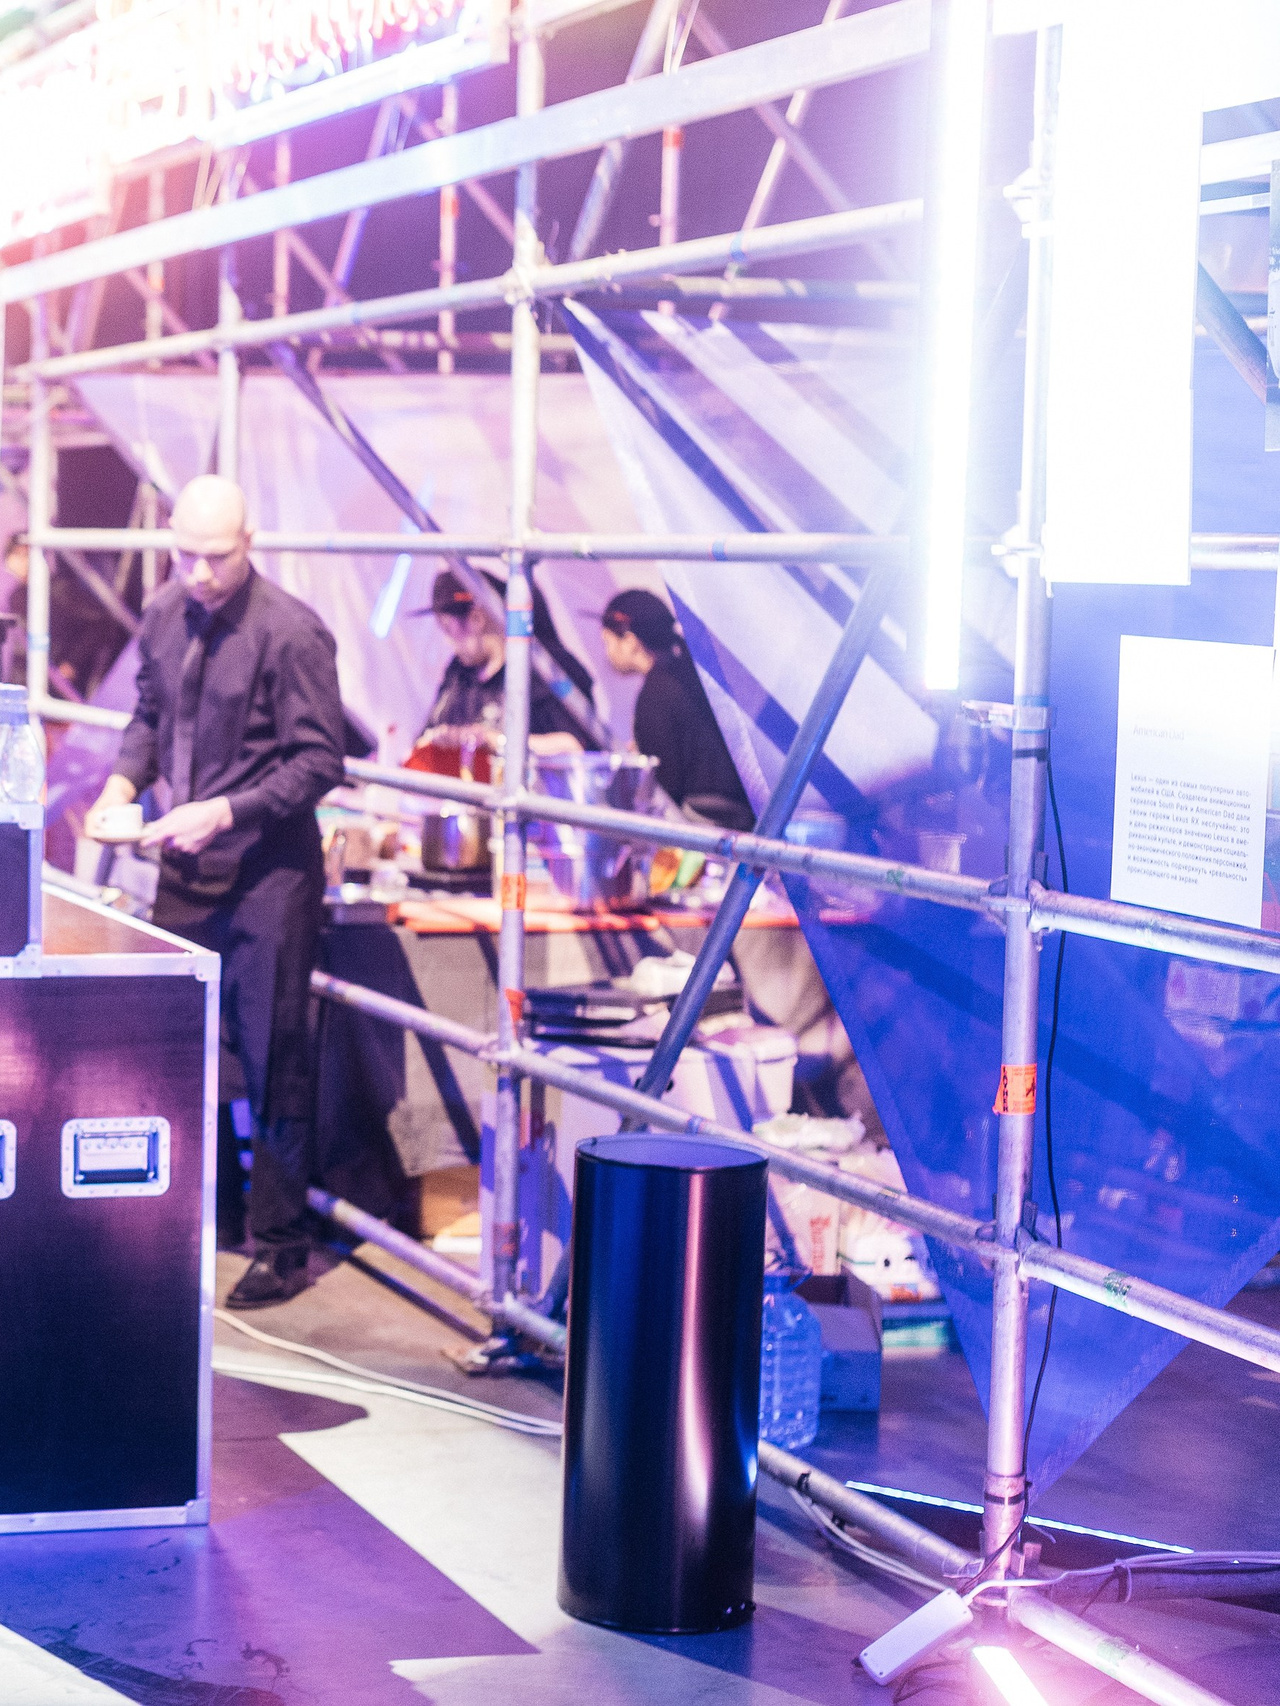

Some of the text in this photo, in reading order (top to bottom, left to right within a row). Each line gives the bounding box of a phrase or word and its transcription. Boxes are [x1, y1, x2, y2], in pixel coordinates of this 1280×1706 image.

[1130, 772, 1146, 782] Lexus
[1155, 777, 1169, 785] один
[1179, 781, 1197, 789] самых
[1199, 784, 1233, 794] популярных
[1130, 784, 1154, 794] мобилей
[1177, 790, 1207, 802] Создатели
[1209, 797, 1250, 808] анимационных
[1129, 808, 1147, 817] своим
[1149, 812, 1170, 820] героям
[1172, 813, 1188, 823] Lexus
[1130, 797, 1156, 806] сериалов
[1158, 799, 1174, 809] South
[1195, 805, 1221, 816] American
[1235, 813, 1250, 821] дали
[1128, 831, 1157, 841] риканской
[1182, 840, 1222, 853] демонстрация
[1133, 820, 1147, 828] дань
[1184, 829, 1212, 839] значению
[1213, 832, 1229, 842] Lexus
[1132, 855, 1169, 867] возможность
[1170, 862, 1207, 874] подчеркнуть
[1181, 852, 1212, 863] положения
[1126, 865, 1170, 878] происходящего
